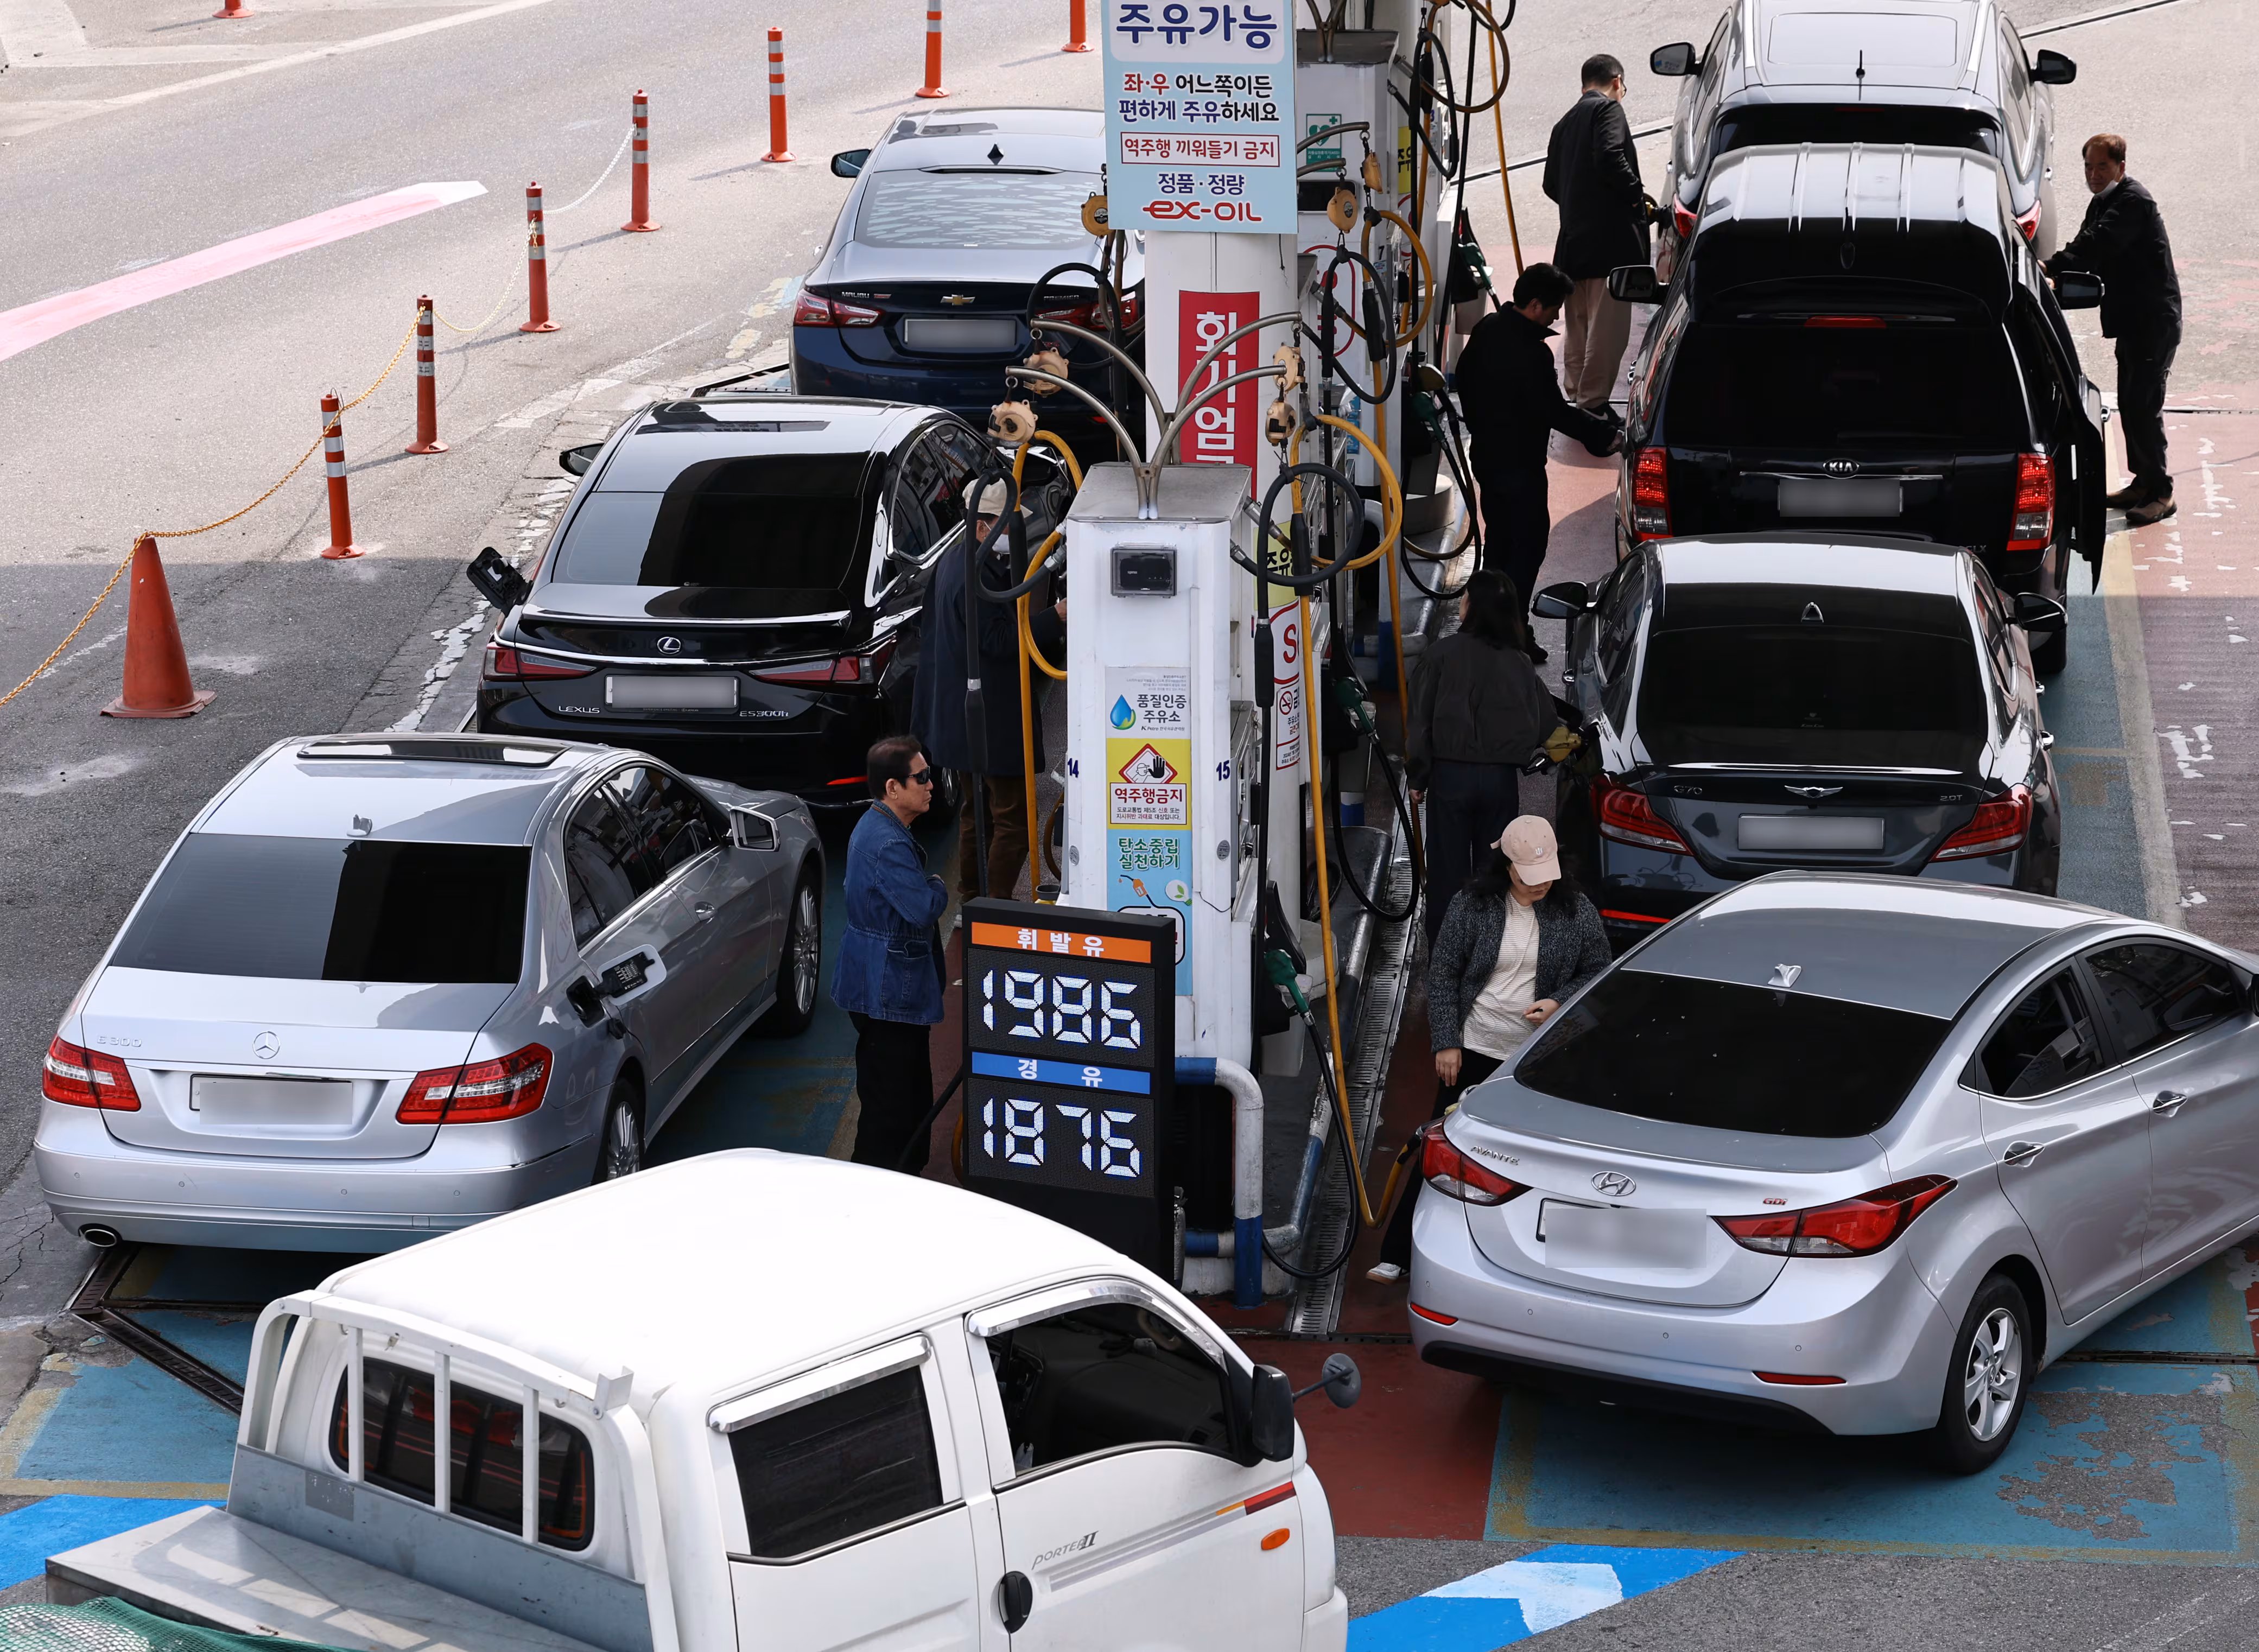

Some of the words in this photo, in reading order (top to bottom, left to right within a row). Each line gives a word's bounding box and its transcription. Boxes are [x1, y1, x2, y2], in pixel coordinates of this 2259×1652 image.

[1116, 4, 1277, 49] 주유가능
[1176, 75, 1272, 98] 어느쪽이든
[1119, 100, 1176, 123] 편하게
[1182, 101, 1279, 123] 주유하세요
[1124, 138, 1171, 158] 역주행
[1176, 140, 1238, 160] 끼워들기
[1243, 142, 1274, 160] 금지
[1829, 462, 1854, 473] KIA
[559, 706, 600, 714] LEXUS
[1137, 694, 1186, 709] 품질인증
[1143, 710, 1181, 723] 주유소
[1068, 758, 1079, 778] 14
[1216, 760, 1230, 781] 15
[1115, 788, 1182, 804] 역주행금지
[1674, 785, 1702, 795] G70
[1118, 837, 1180, 855] 탄소중립
[1118, 854, 1180, 871] 실천하기
[982, 969, 1140, 1050] 1986
[982, 1097, 1140, 1178] 1876
[1469, 1144, 1519, 1166] AVANTE
[1763, 1197, 1788, 1206] GDi
